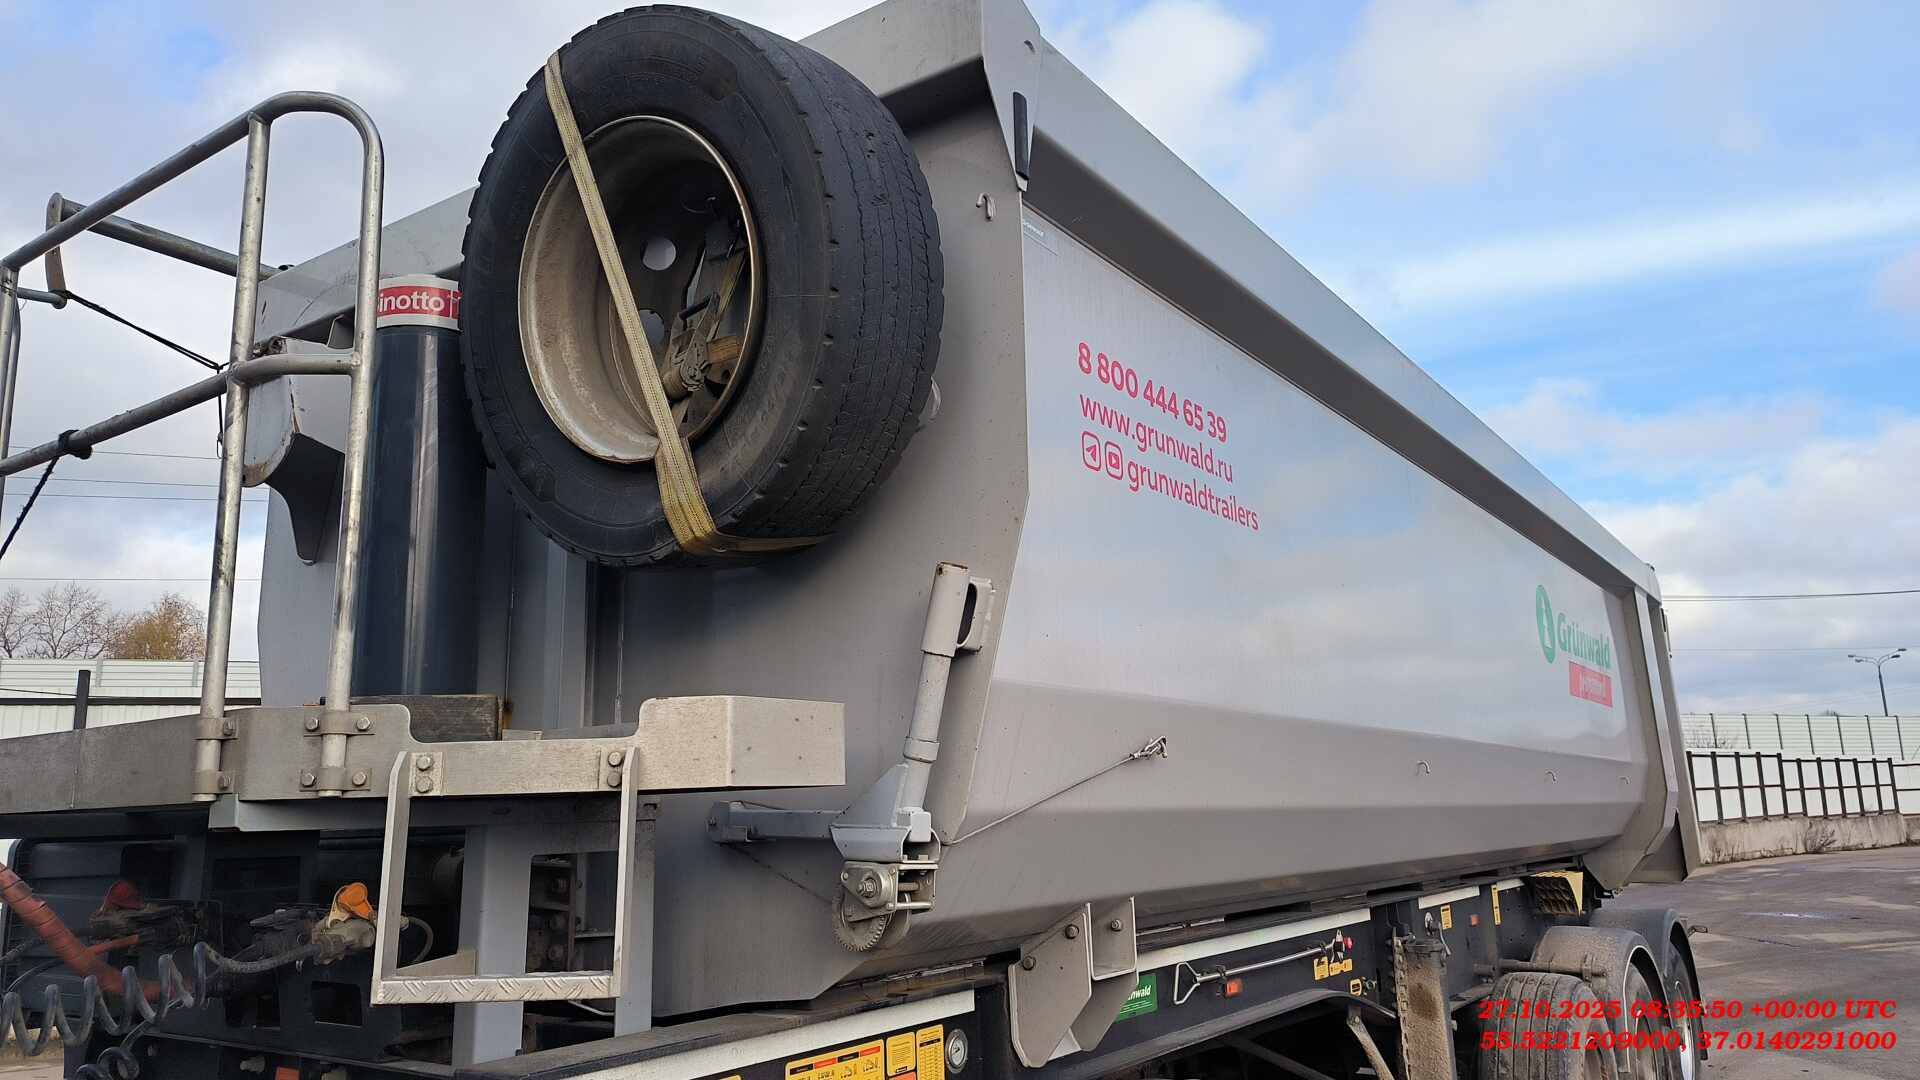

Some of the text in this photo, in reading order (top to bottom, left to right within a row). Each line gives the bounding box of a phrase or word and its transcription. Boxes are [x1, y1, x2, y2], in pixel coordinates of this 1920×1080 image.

[377, 290, 446, 312] inotto
[1078, 342, 1227, 443] 8 800 444 65 39
[1079, 393, 1233, 483] www.grunwald.ru
[1127, 459, 1259, 530] grunwaldtrailers
